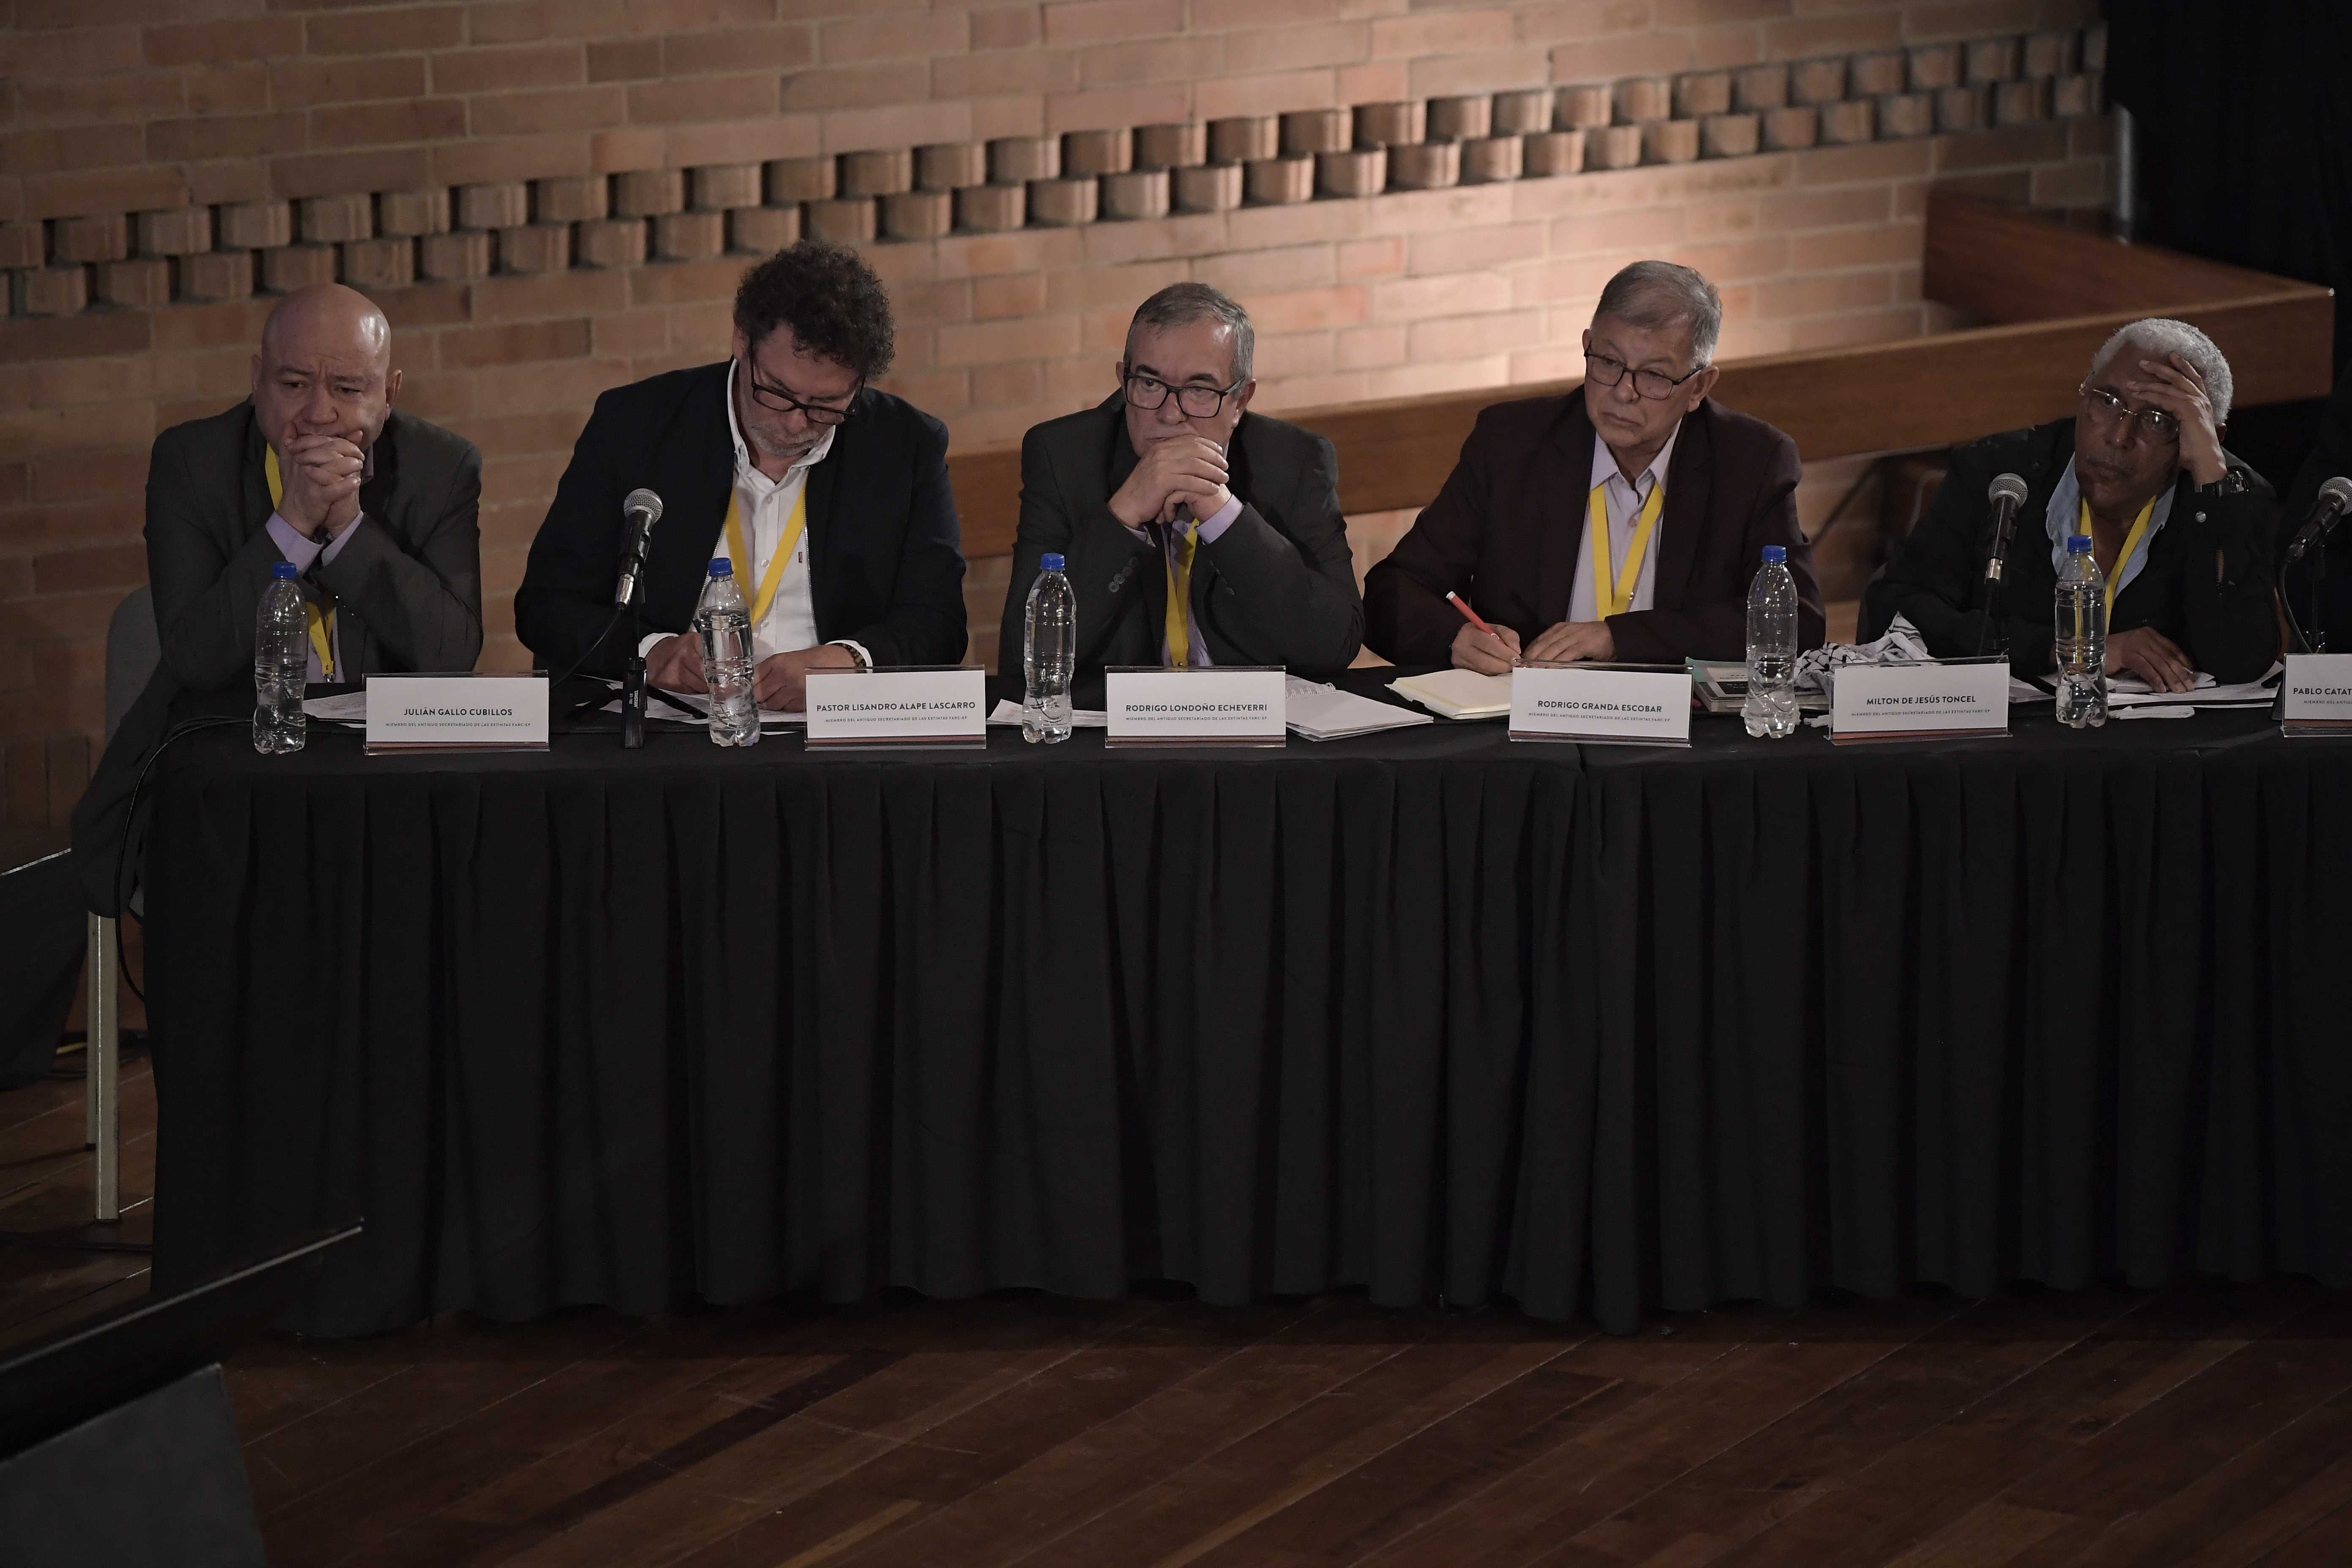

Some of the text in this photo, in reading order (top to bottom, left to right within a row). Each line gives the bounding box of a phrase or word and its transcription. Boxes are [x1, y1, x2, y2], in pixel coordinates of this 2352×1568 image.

[1914, 694, 1940, 704] JESÚS
[1170, 703, 1216, 712] LONDOÑO
[1538, 700, 1662, 713] RODRIGO GRANDA ESCOBAR
[404, 707, 436, 716] JULIÁN
